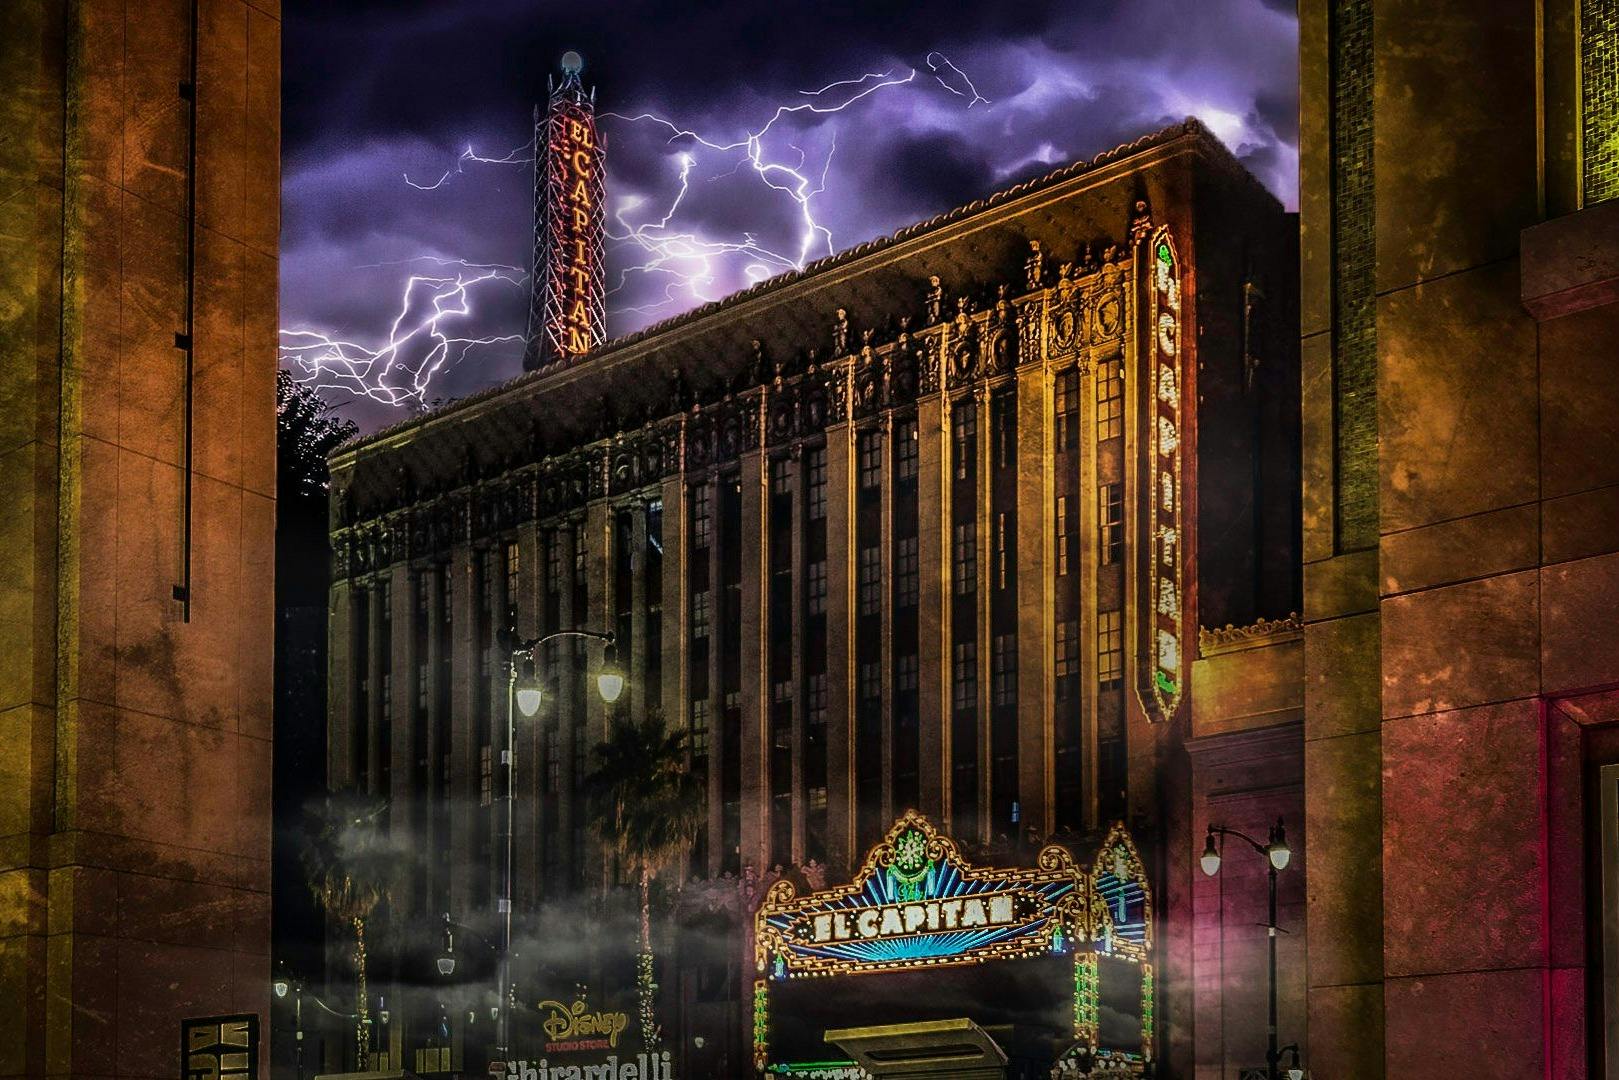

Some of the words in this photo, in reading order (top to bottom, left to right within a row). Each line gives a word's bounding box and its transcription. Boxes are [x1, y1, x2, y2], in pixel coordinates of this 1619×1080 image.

[571, 121, 593, 148] EL
[568, 150, 593, 354] CAPITAN
[814, 913, 850, 942] EL
[857, 894, 1013, 938] CAPITAN
[545, 1041, 578, 1052] STUDIO
[580, 1039, 610, 1050] STORE
